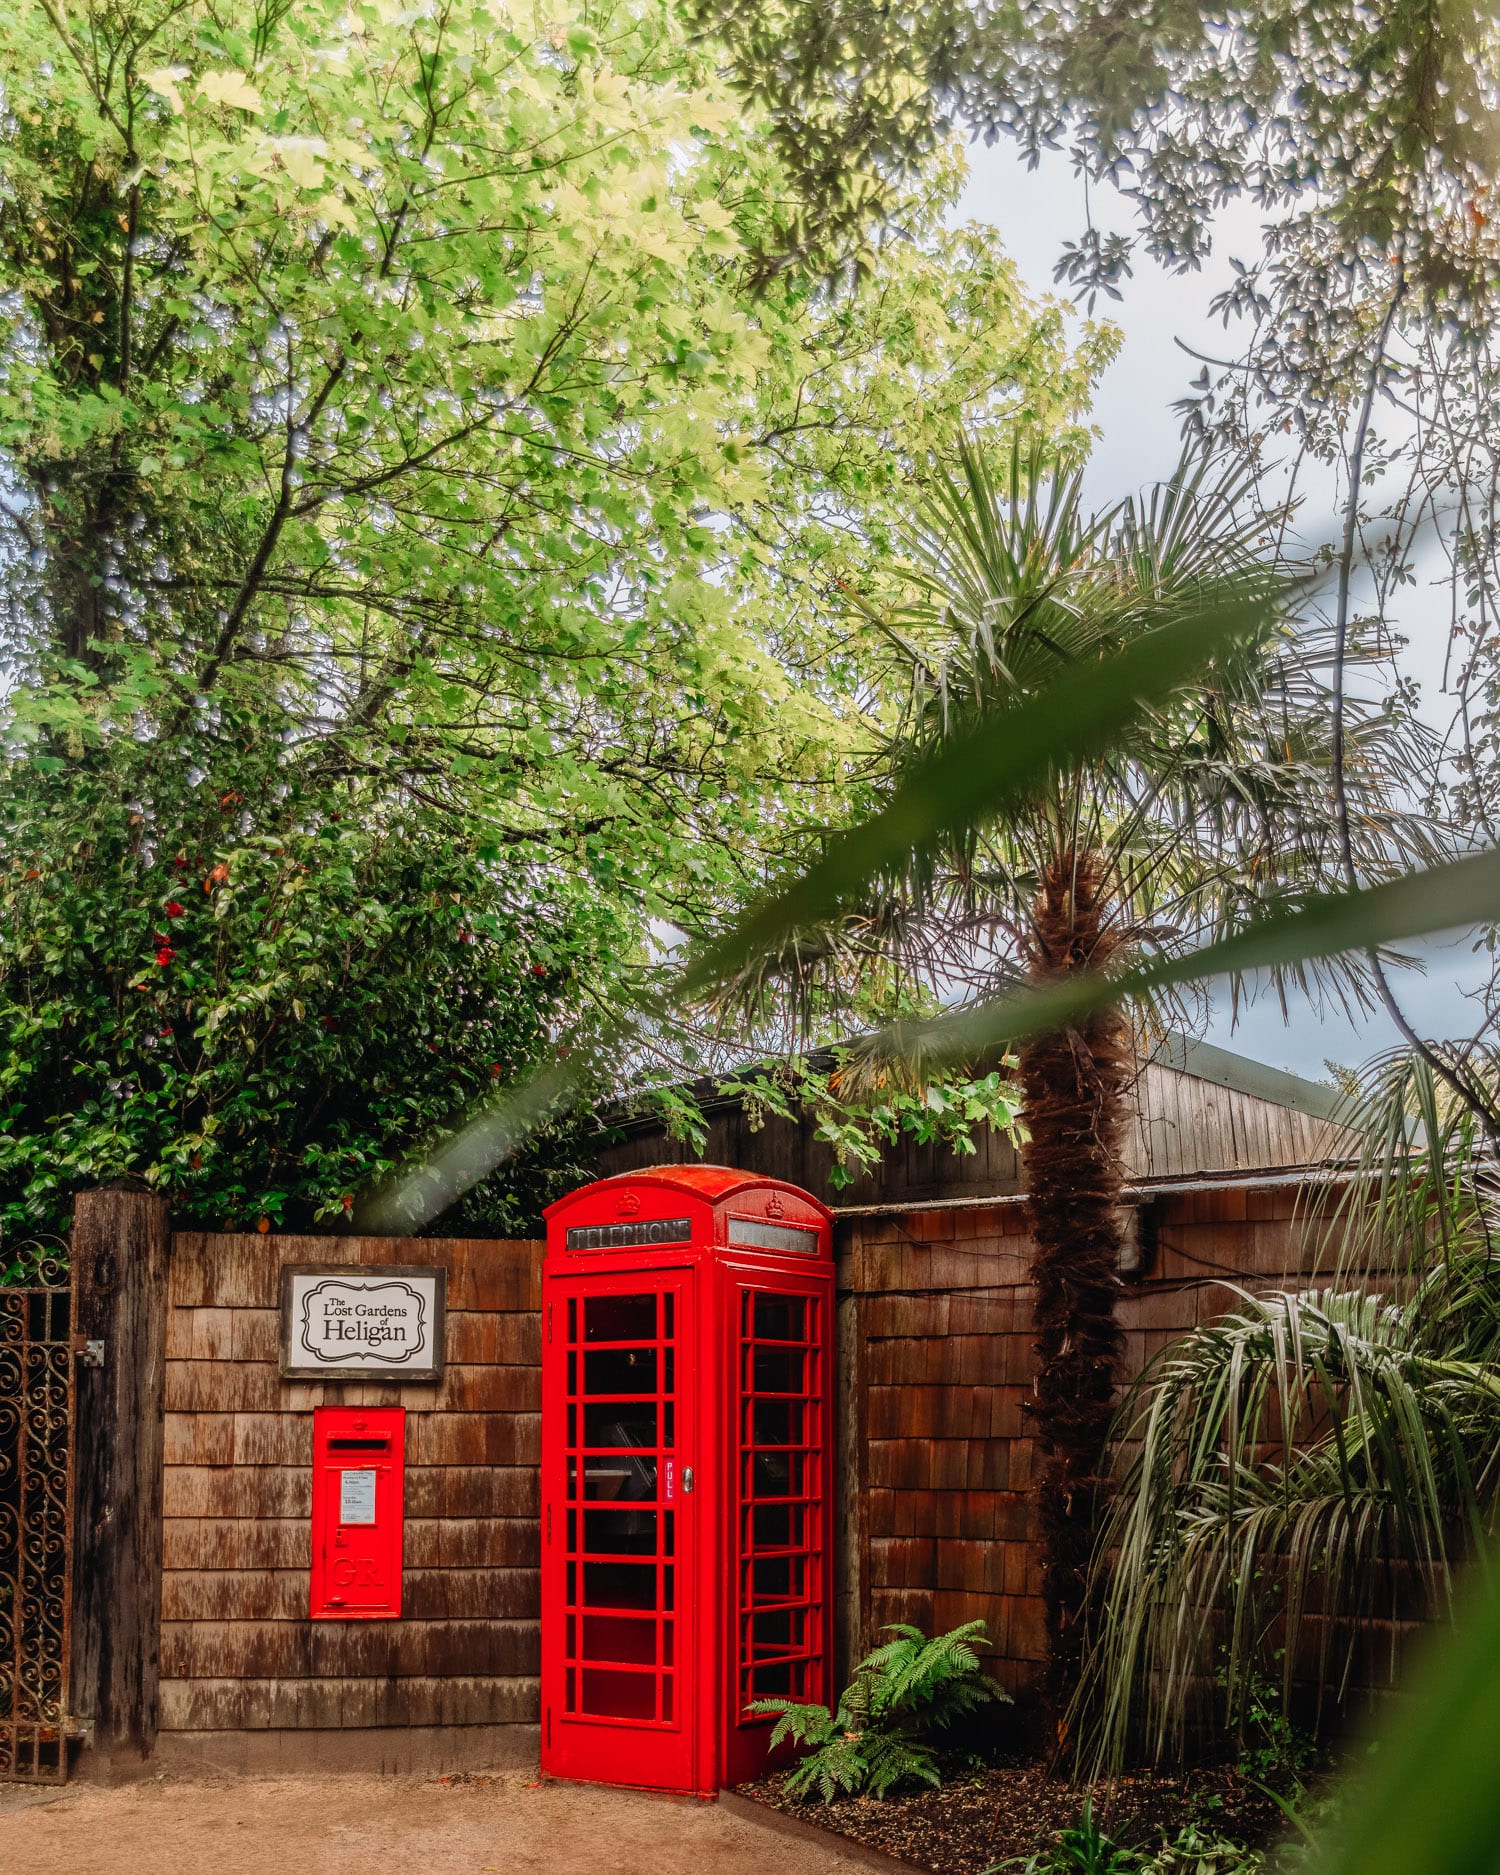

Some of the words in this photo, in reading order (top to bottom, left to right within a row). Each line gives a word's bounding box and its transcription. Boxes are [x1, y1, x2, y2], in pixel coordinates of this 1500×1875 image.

[572, 1220, 688, 1248] TELEPHONE
[323, 1304, 352, 1316] Lost
[355, 1304, 407, 1317] Gardens
[329, 1297, 346, 1306] The
[380, 1317, 389, 1326] of
[323, 1320, 407, 1347] Heligan
[333, 1557, 384, 1587] GR
